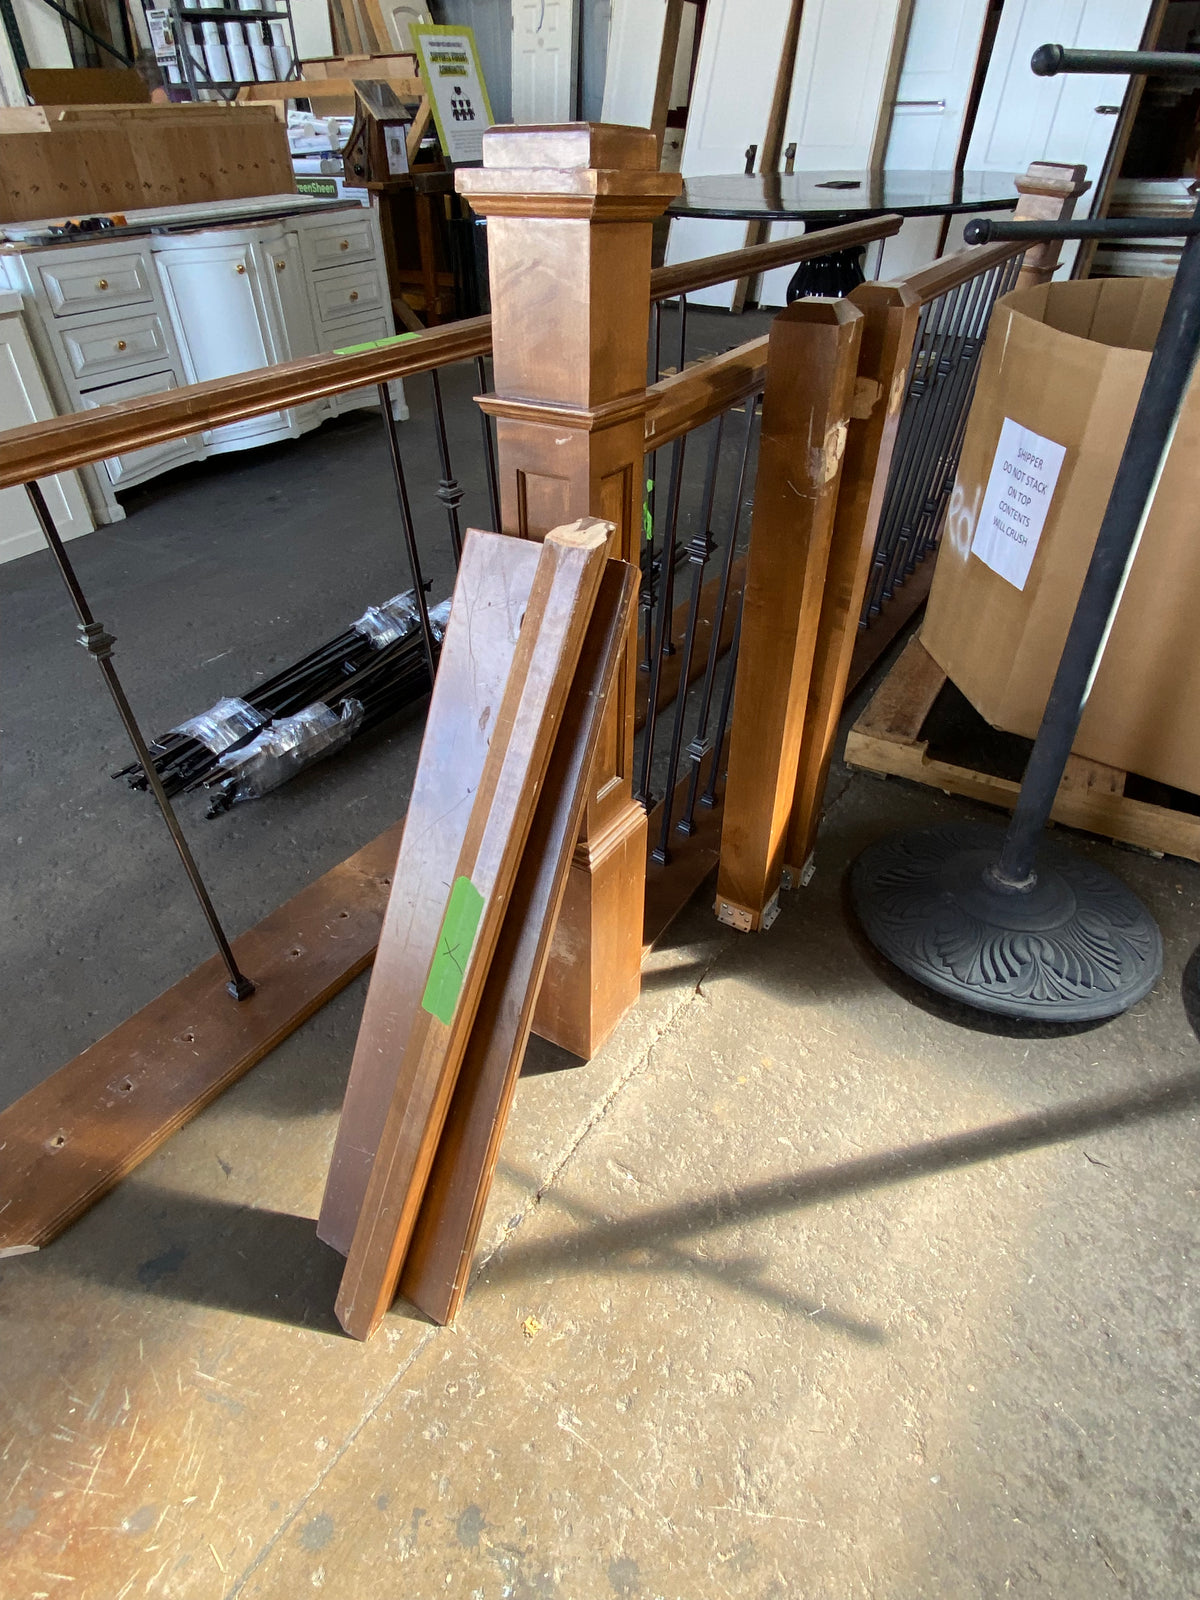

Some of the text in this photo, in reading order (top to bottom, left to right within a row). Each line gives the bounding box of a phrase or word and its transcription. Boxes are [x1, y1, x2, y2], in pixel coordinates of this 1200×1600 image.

[297, 182, 335, 193] reenSheen
[1017, 448, 1043, 470] SHIPPER
[1003, 460, 1048, 495] DO NOT STACK
[1008, 486, 1032, 506] ON TOP
[999, 500, 1031, 527] CONTENTS
[993, 516, 1029, 547] WILL CRUSH
